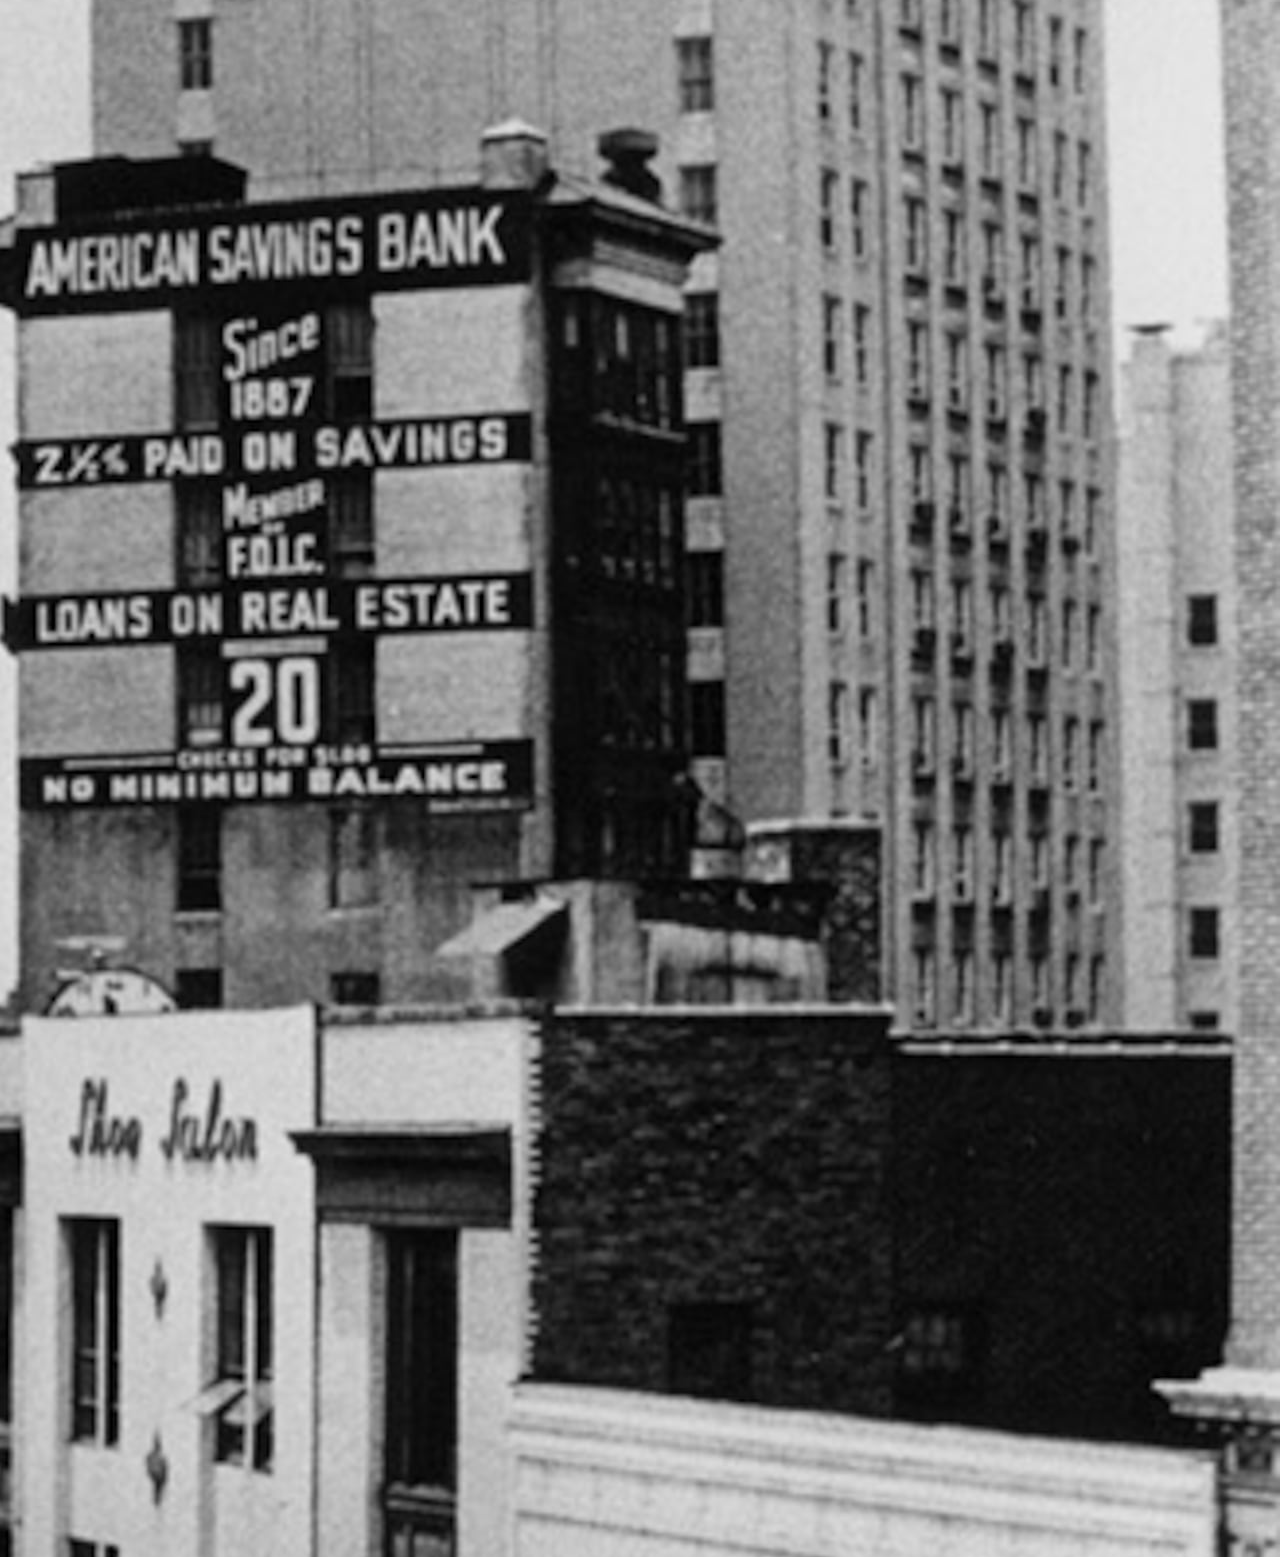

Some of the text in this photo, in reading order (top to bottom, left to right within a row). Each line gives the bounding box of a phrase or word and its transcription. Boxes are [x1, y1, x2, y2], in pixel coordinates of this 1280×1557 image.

[25, 206, 506, 298] AMERICAN SAVINGS BANK
[223, 313, 320, 381] Since
[230, 378, 312, 419] 1887
[145, 436, 223, 476] PAID
[244, 431, 296, 471] ON
[316, 421, 509, 466] SAVINGS
[39, 580, 510, 644] LOANS ON REAL ESTATE
[230, 655, 320, 746] 20
[43, 760, 507, 802] NO MINIMUM BALANCE
[265, 746, 306, 767] FOR
[161, 1077, 258, 1164] Salon
